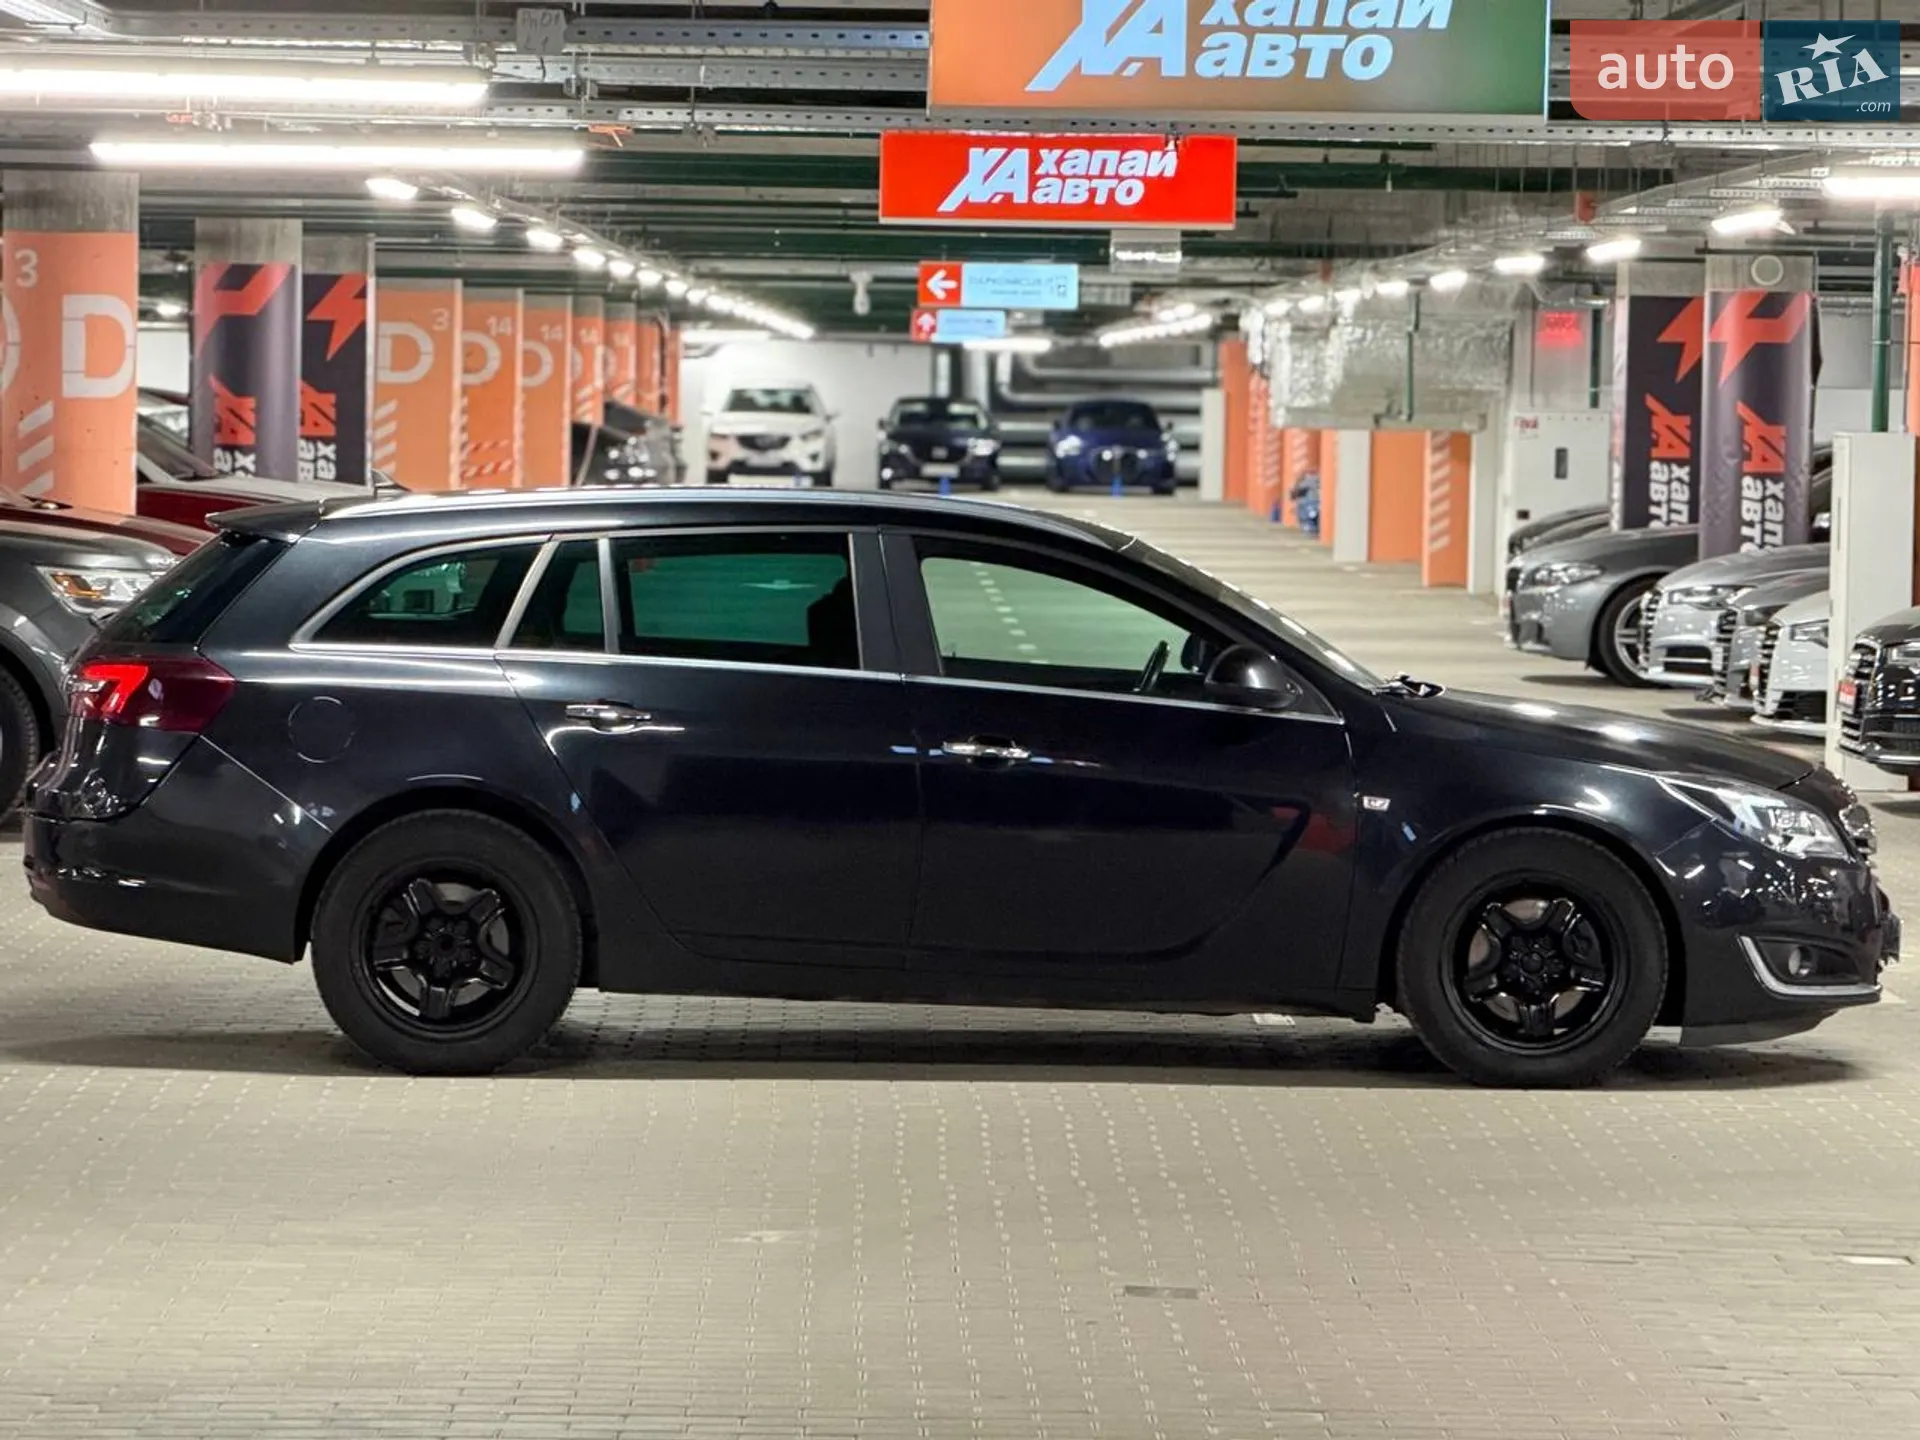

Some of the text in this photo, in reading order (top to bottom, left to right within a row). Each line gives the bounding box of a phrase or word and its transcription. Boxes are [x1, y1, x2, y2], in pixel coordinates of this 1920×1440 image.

[1194, 32, 1393, 81] авто
[1035, 140, 1178, 177] хапай
[1032, 177, 1145, 205] авто
[14, 248, 39, 288] 3
[62, 294, 136, 398] D
[376, 308, 450, 383] D 3
[487, 316, 513, 337] 14
[1669, 464, 1691, 527] хап
[1763, 478, 1785, 550] хап
